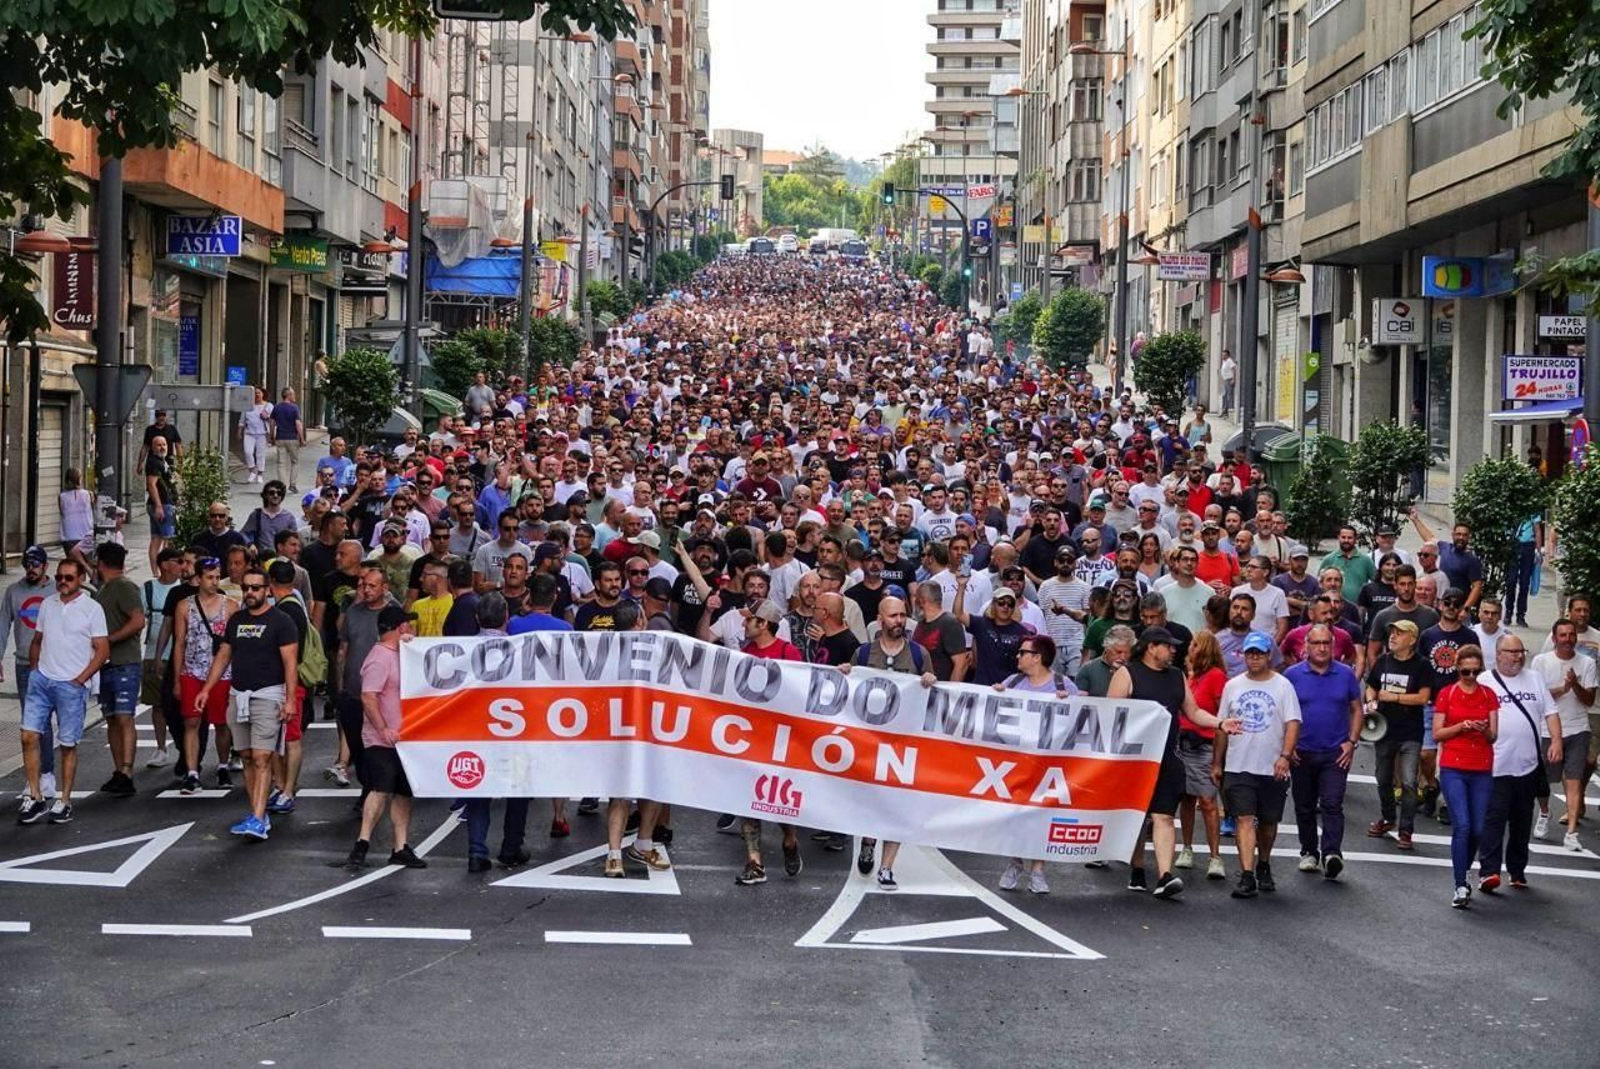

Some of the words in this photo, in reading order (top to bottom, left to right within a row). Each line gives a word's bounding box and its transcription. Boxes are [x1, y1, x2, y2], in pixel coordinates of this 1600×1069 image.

[969, 186, 995, 199] FARO
[170, 217, 238, 236] BAZAR
[976, 221, 988, 236] P
[180, 237, 227, 253] ASIA
[54, 308, 92, 323] Chus
[1555, 318, 1582, 326] PAPEL
[1509, 359, 1576, 368] SUPERMERCADO
[1509, 369, 1576, 379] TRUJILLO
[1515, 381, 1537, 398] 24
[1538, 384, 1563, 394] HORAS
[424, 632, 782, 703] CONVENIO
[805, 666, 900, 725] DO
[922, 687, 1143, 756] METAL
[487, 697, 919, 785] SOLUCIÓN
[969, 756, 1073, 805] XA
[451, 756, 488, 773] UGT
[755, 774, 802, 808] CIG
[752, 802, 799, 817] INDUSTRIA
[1052, 826, 1101, 841] CCOO
[1046, 843, 1098, 856] industria
